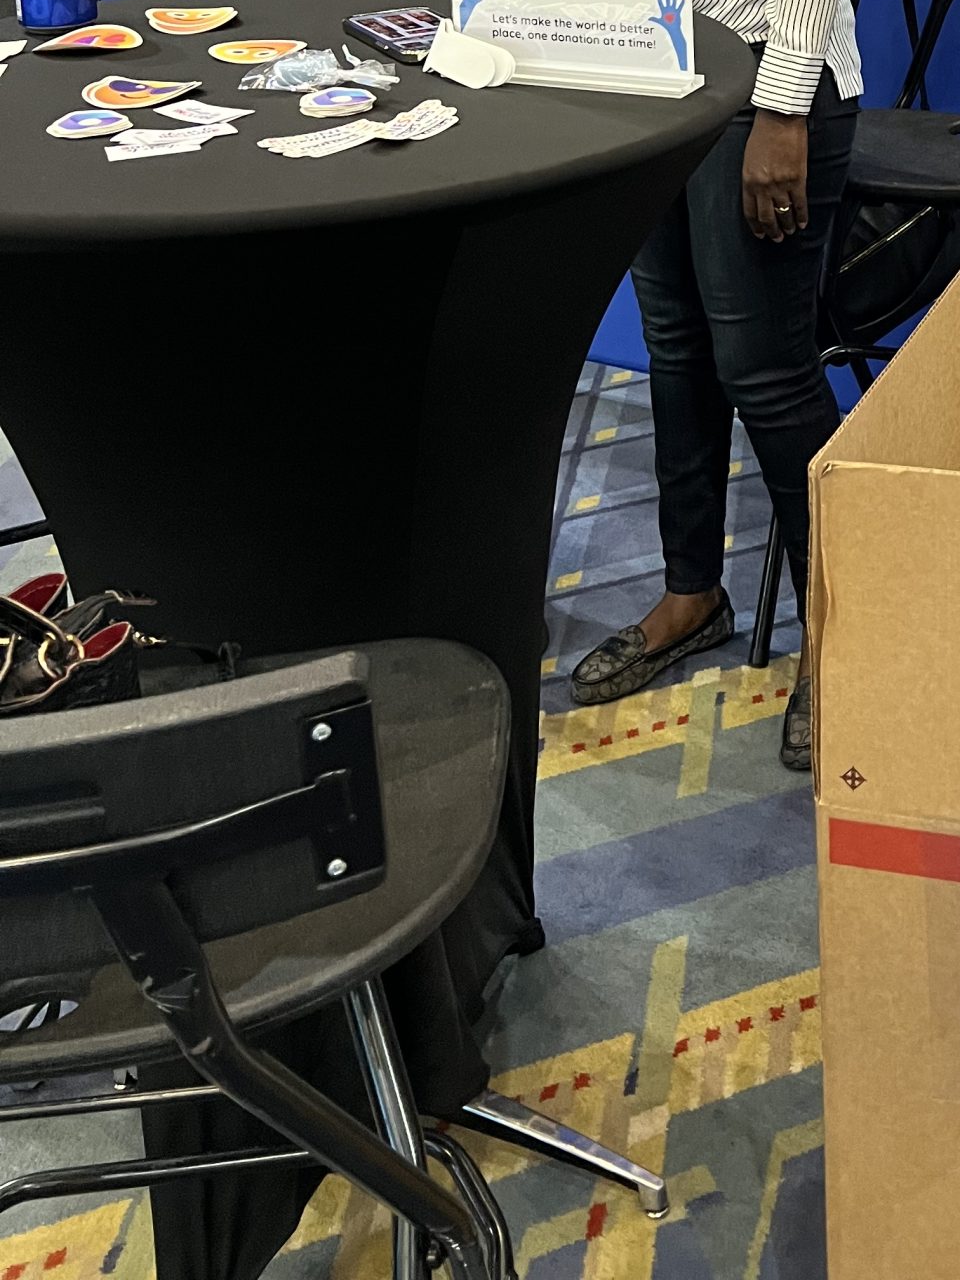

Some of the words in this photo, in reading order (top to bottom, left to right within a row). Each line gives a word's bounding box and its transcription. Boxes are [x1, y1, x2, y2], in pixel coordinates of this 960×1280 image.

[492, 14, 517, 24] Let's
[521, 17, 551, 27] make
[555, 19, 572, 28] the
[576, 21, 606, 31] world
[620, 24, 654, 35] better
[492, 28, 525, 40] place,
[528, 32, 548, 40] one
[551, 33, 600, 45] donation
[603, 36, 615, 46] at
[629, 39, 656, 49] time!
